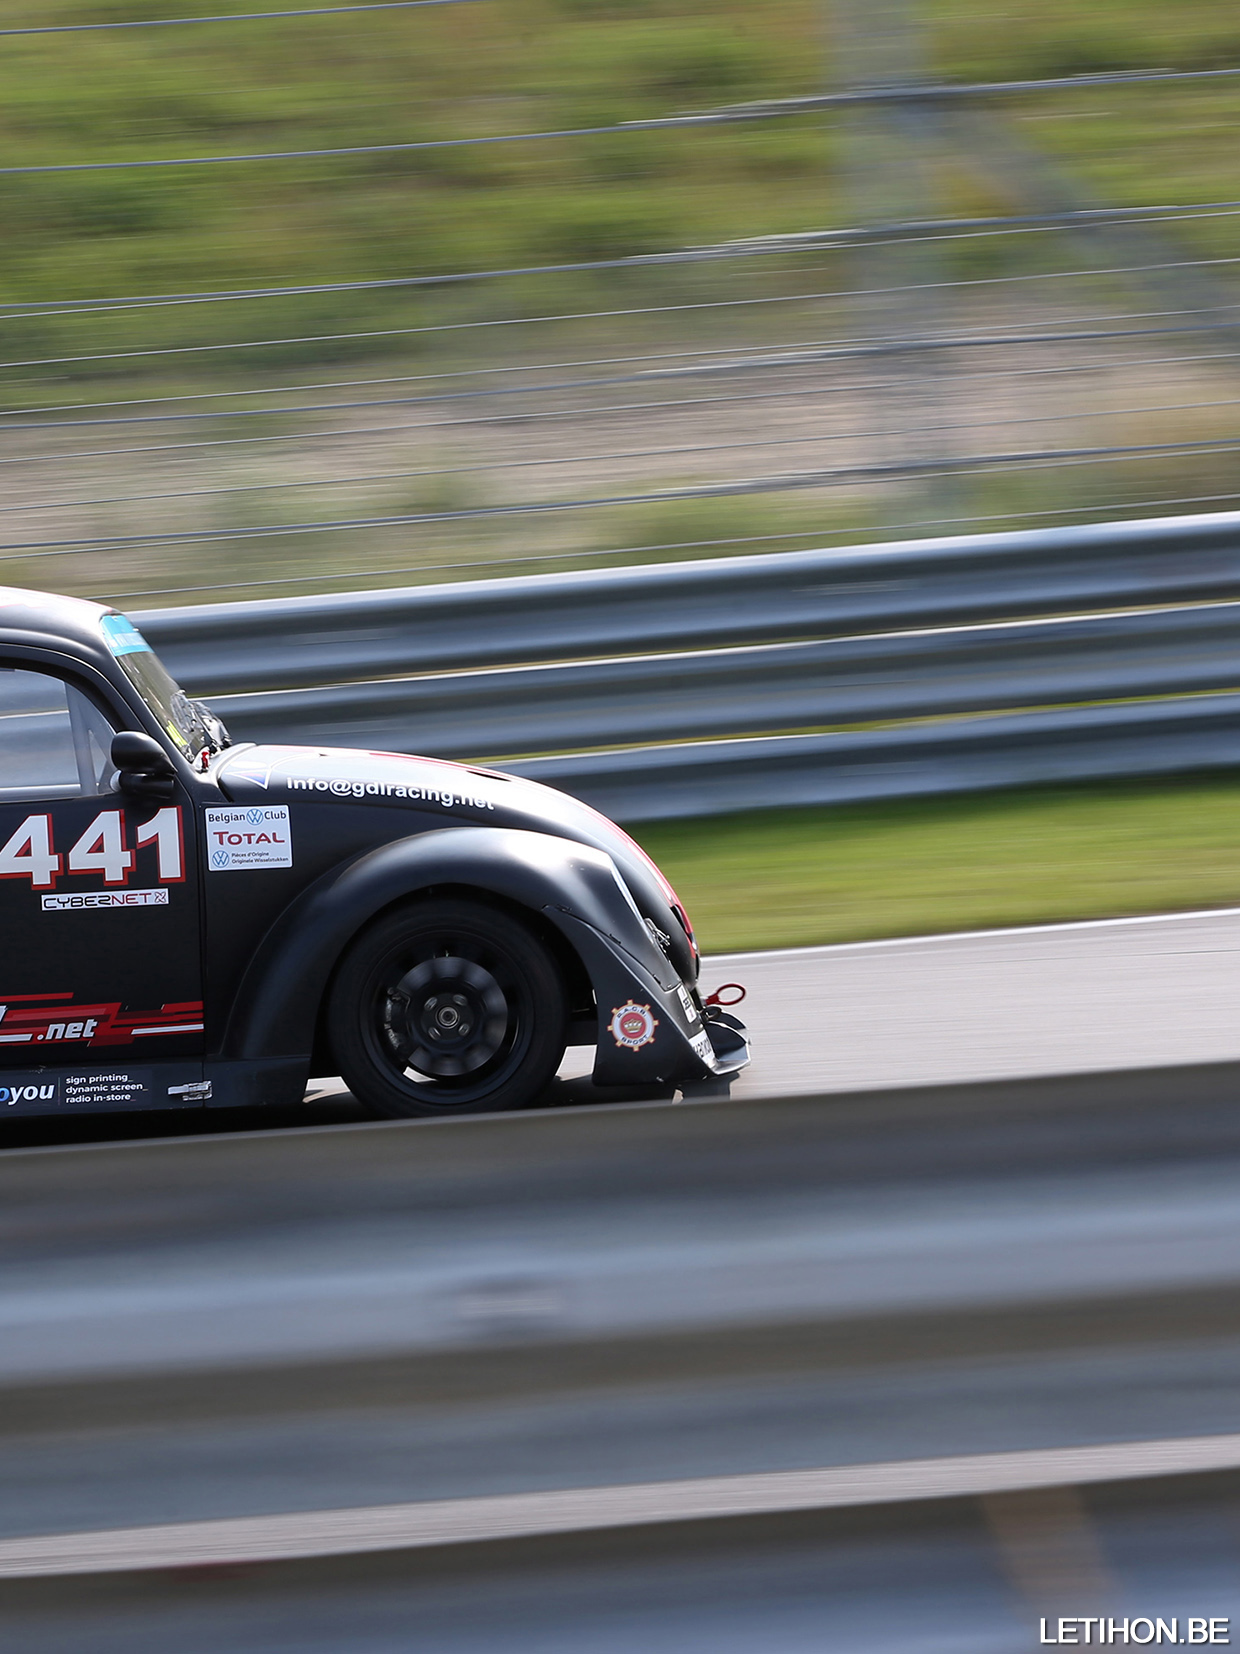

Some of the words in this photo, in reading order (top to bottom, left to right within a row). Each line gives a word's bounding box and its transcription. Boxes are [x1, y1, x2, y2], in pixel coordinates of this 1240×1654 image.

[286, 776, 496, 811] info@gdlracing.net
[208, 813, 246, 824] Belgian
[264, 811, 287, 820] Club
[213, 831, 286, 846] TOTAL
[65, 1076, 86, 1085] sign
[65, 1084, 108, 1094] dynamic
[65, 1095, 91, 1104] radio
